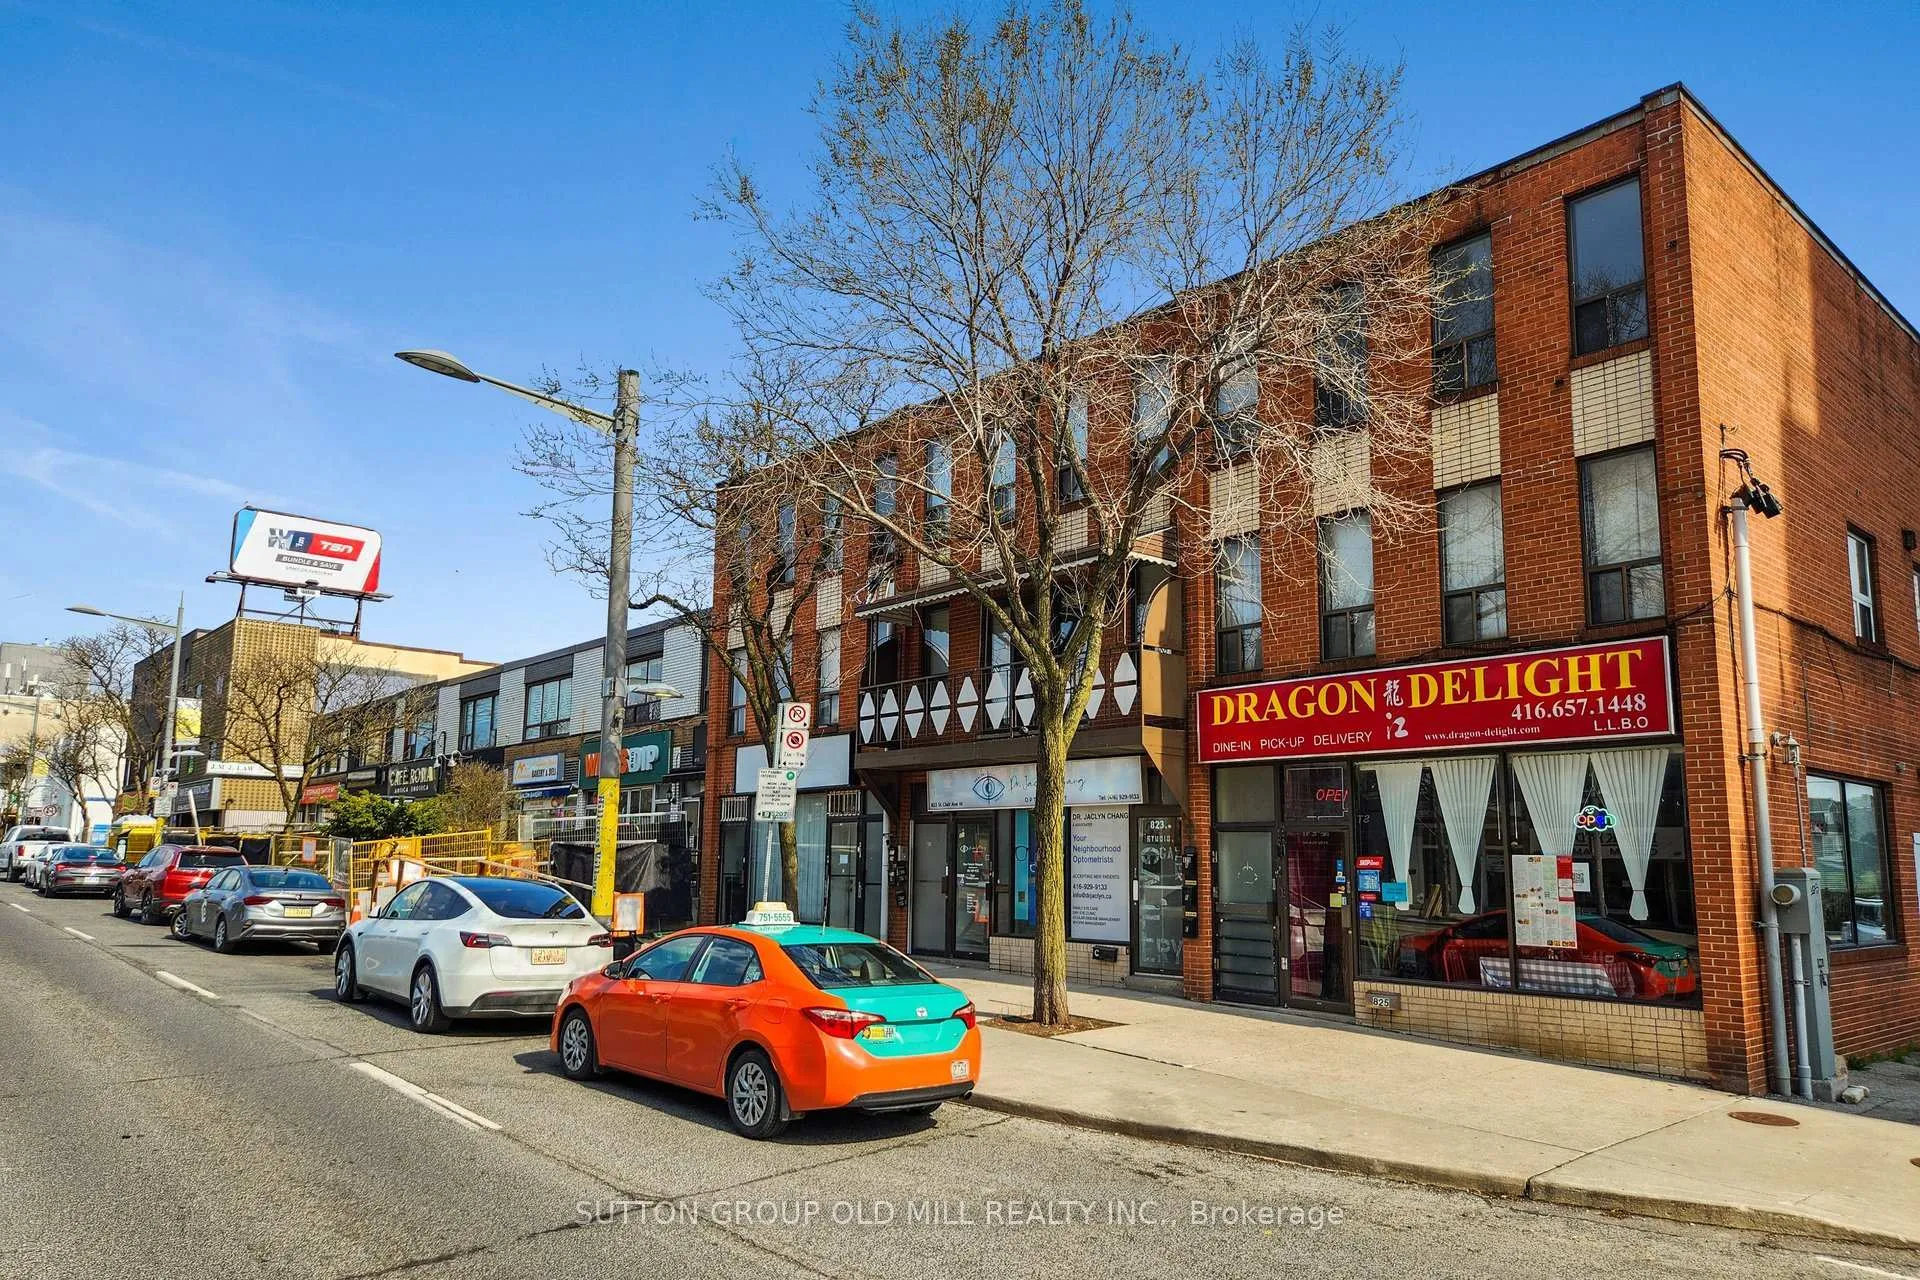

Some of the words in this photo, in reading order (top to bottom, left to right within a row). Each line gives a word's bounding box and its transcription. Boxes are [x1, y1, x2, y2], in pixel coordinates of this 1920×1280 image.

[320, 540, 354, 553] TSN
[282, 556, 311, 566] BUNDLE
[319, 561, 338, 569] SAVE
[1211, 678, 1377, 726] DRAGON
[1407, 649, 1643, 709] DELIGHT
[1511, 693, 1647, 721] 416.657.1448
[1593, 716, 1649, 732] L.L.B.O
[1424, 725, 1541, 741] www.dragon-delight.com
[1213, 740, 1251, 753] DINE-IN
[1260, 736, 1305, 750] PICK-UP
[1314, 731, 1373, 746] DELIVERY
[1577, 815, 1612, 826] open
[1072, 834, 1087, 842] Your
[1072, 845, 1121, 853] Neighbourhood
[1072, 855, 1113, 864] Optometrists
[759, 912, 792, 922] 751-5555
[1373, 997, 1389, 1007] 825
